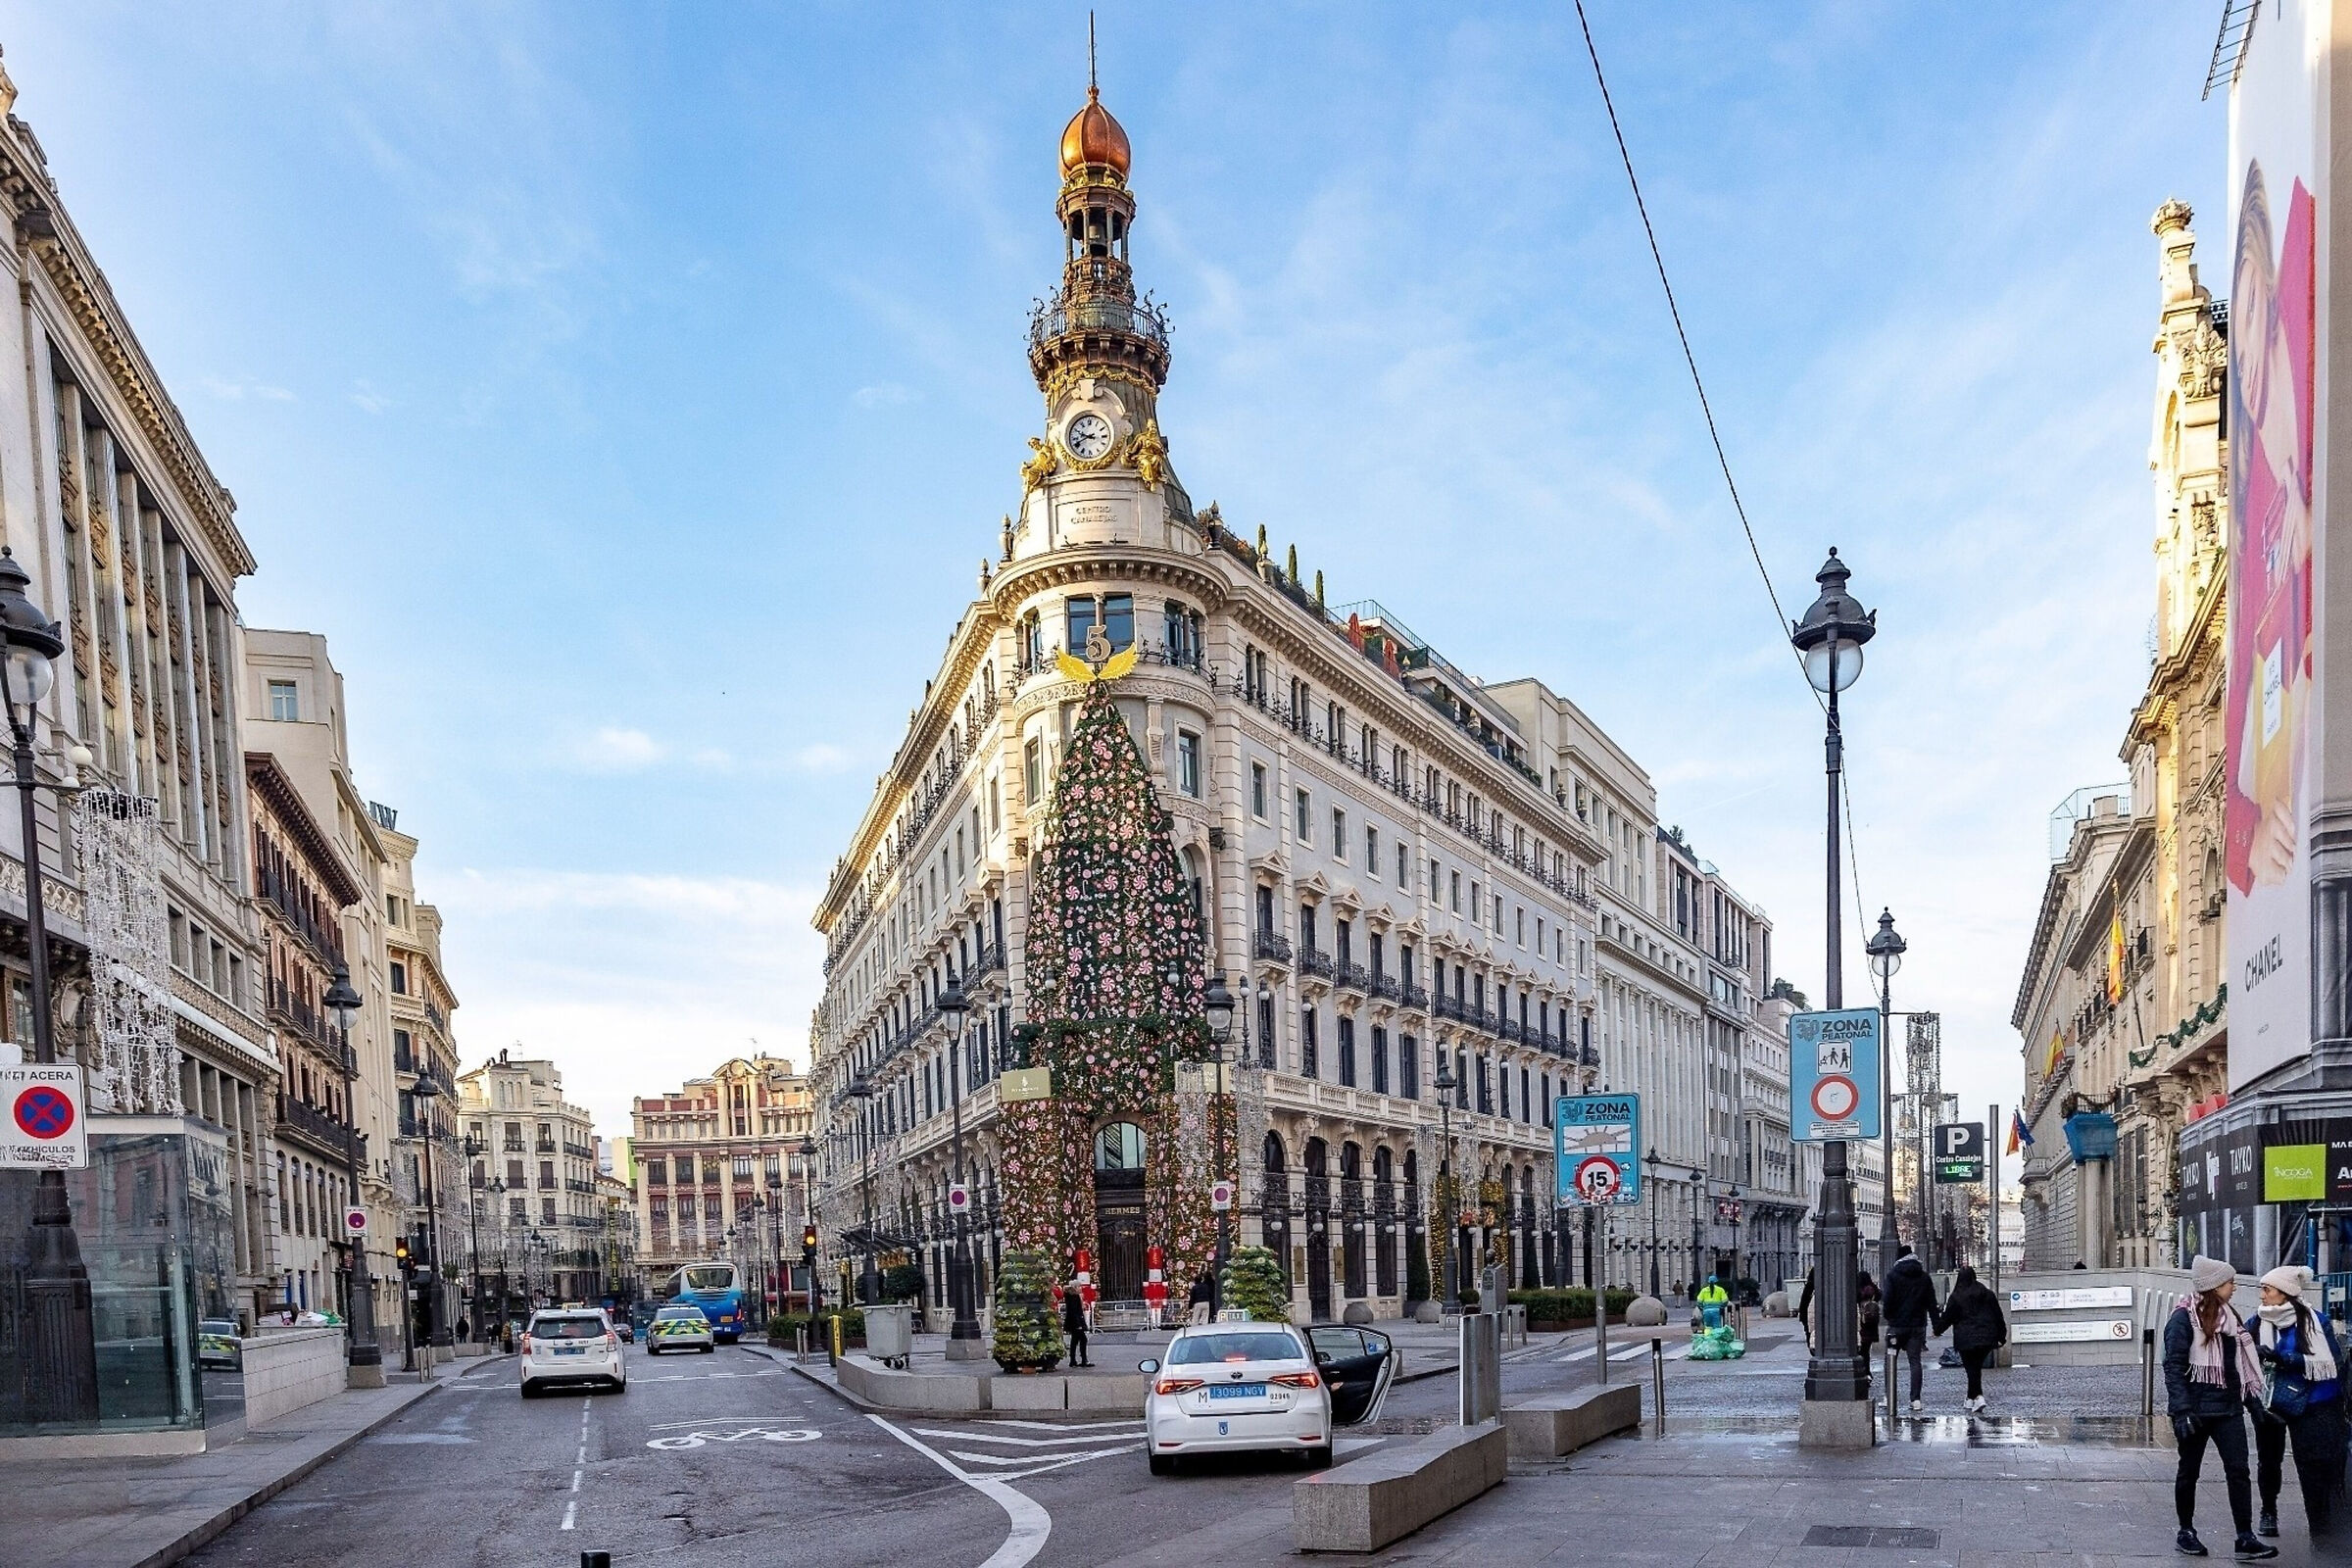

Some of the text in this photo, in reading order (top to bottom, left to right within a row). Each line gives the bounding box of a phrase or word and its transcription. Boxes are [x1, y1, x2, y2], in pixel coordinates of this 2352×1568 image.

[1085, 625, 1111, 662] 5
[2245, 933, 2283, 993] CHANEL
[1823, 1018, 1873, 1033] ZONA
[1822, 1030, 1874, 1040] PEATONAL
[29, 1071, 74, 1081] ACERA
[1585, 1102, 1631, 1115] ZONA
[1585, 1113, 1632, 1122] PEATONAL
[1947, 1127, 1971, 1154] P
[2230, 1145, 2253, 1176] TAYKO
[1945, 1165, 1972, 1174] LIBRE
[1588, 1171, 1607, 1188] 15
[1198, 1392, 1208, 1403] M
[1217, 1387, 1243, 1397] 3099
